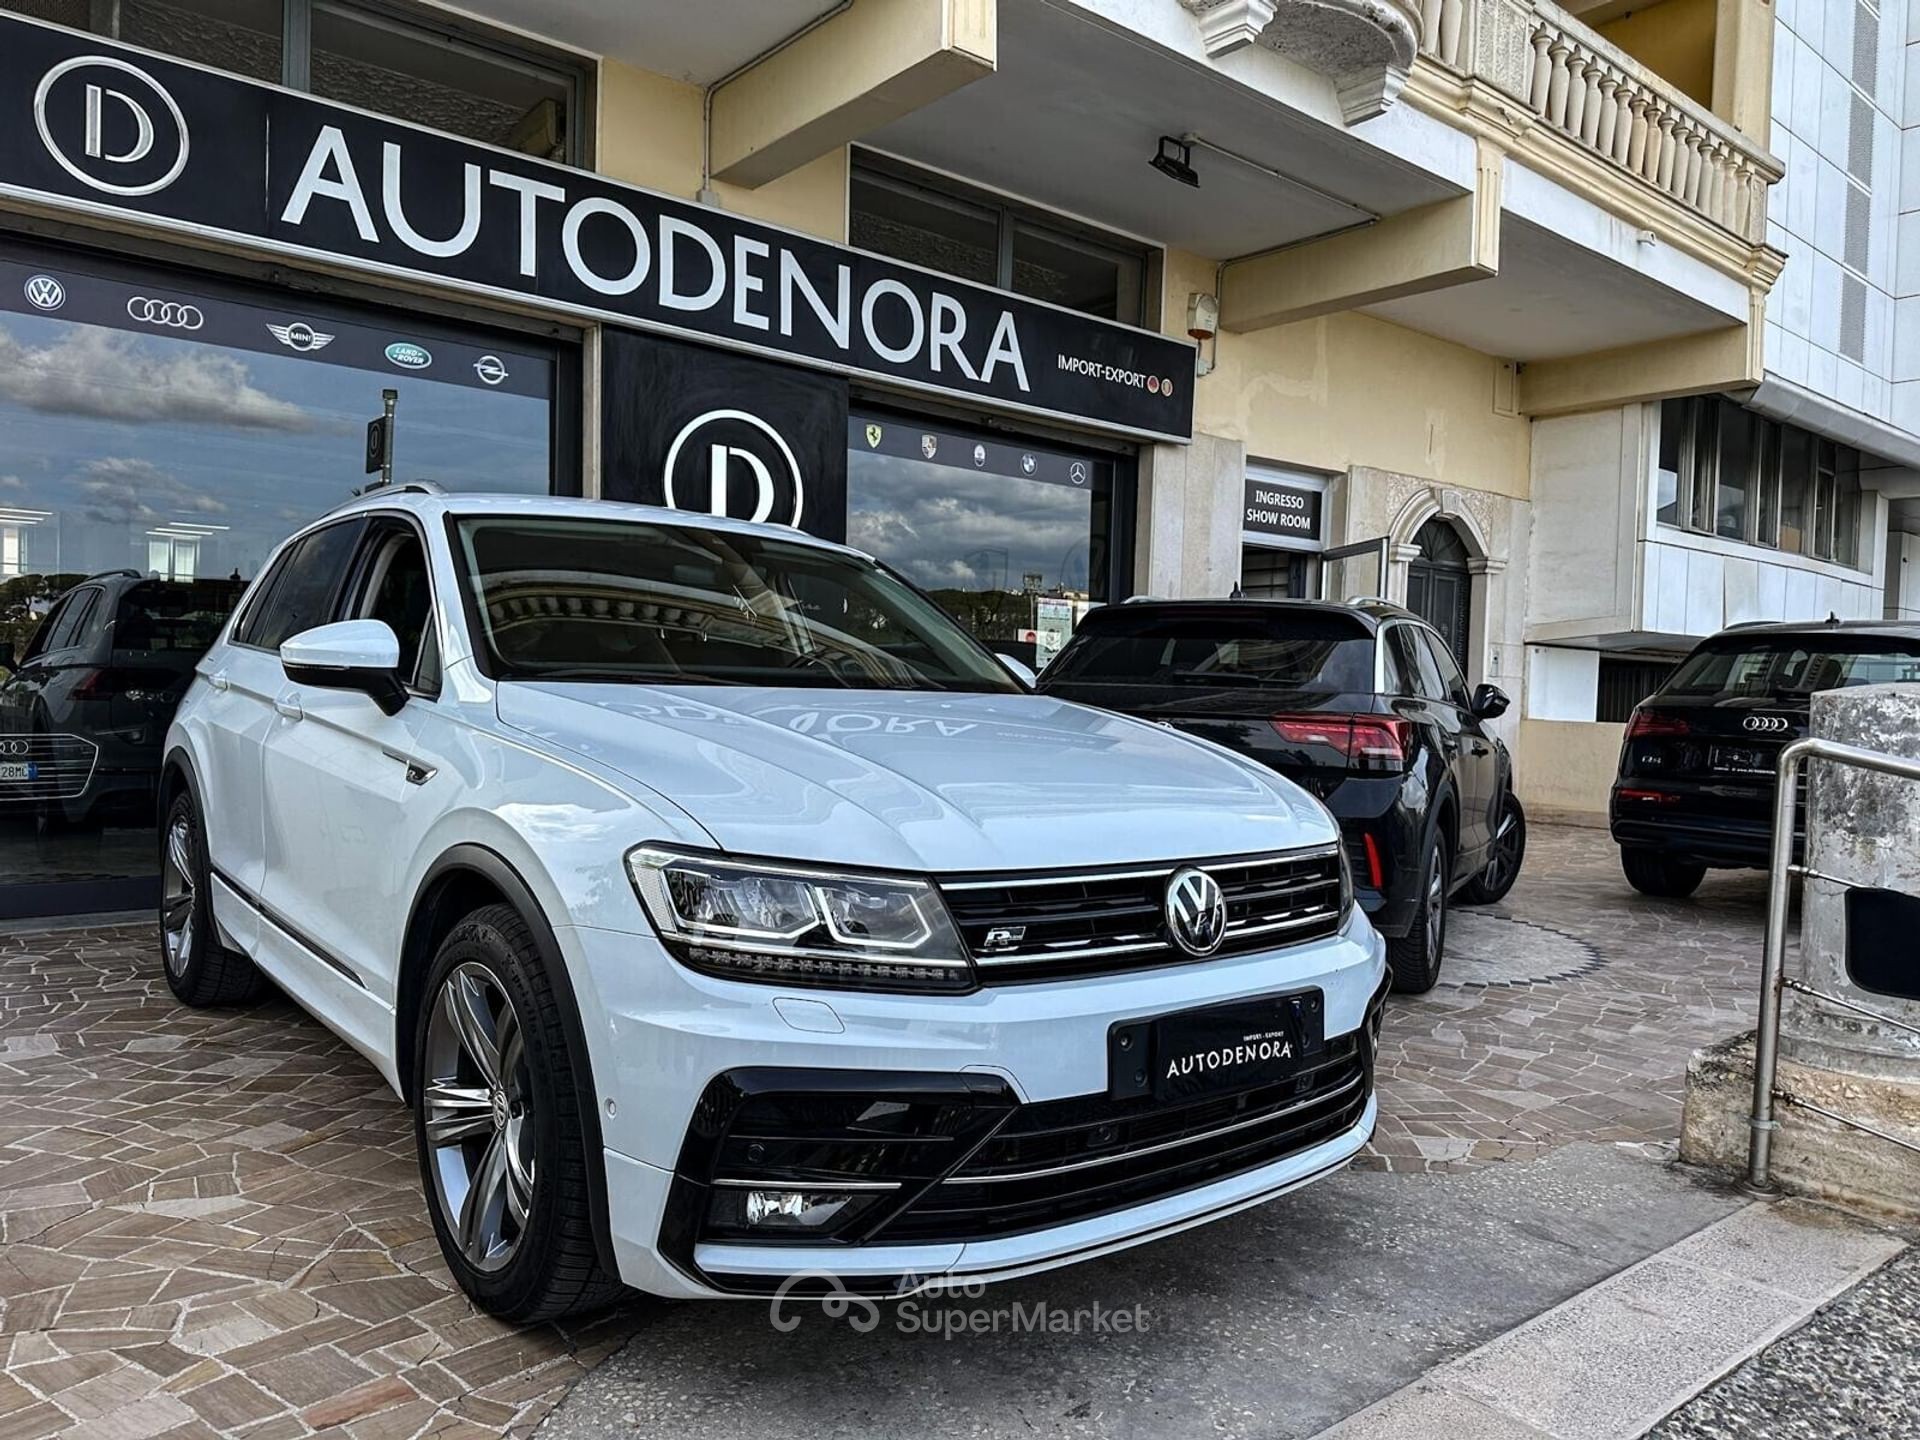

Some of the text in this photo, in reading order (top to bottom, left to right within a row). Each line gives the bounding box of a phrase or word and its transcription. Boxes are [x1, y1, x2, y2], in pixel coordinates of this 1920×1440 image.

[281, 125, 1031, 392] AUTODENORA
[290, 332, 311, 343] MINI
[395, 346, 417, 358] LAND
[396, 354, 425, 366] ROVER
[1058, 354, 1146, 389] IMPORT-EXPORT
[1255, 490, 1304, 509] INGRESSO
[1246, 508, 1311, 530] SHOW ROOM
[1166, 1040, 1292, 1079] AUTODENORA
